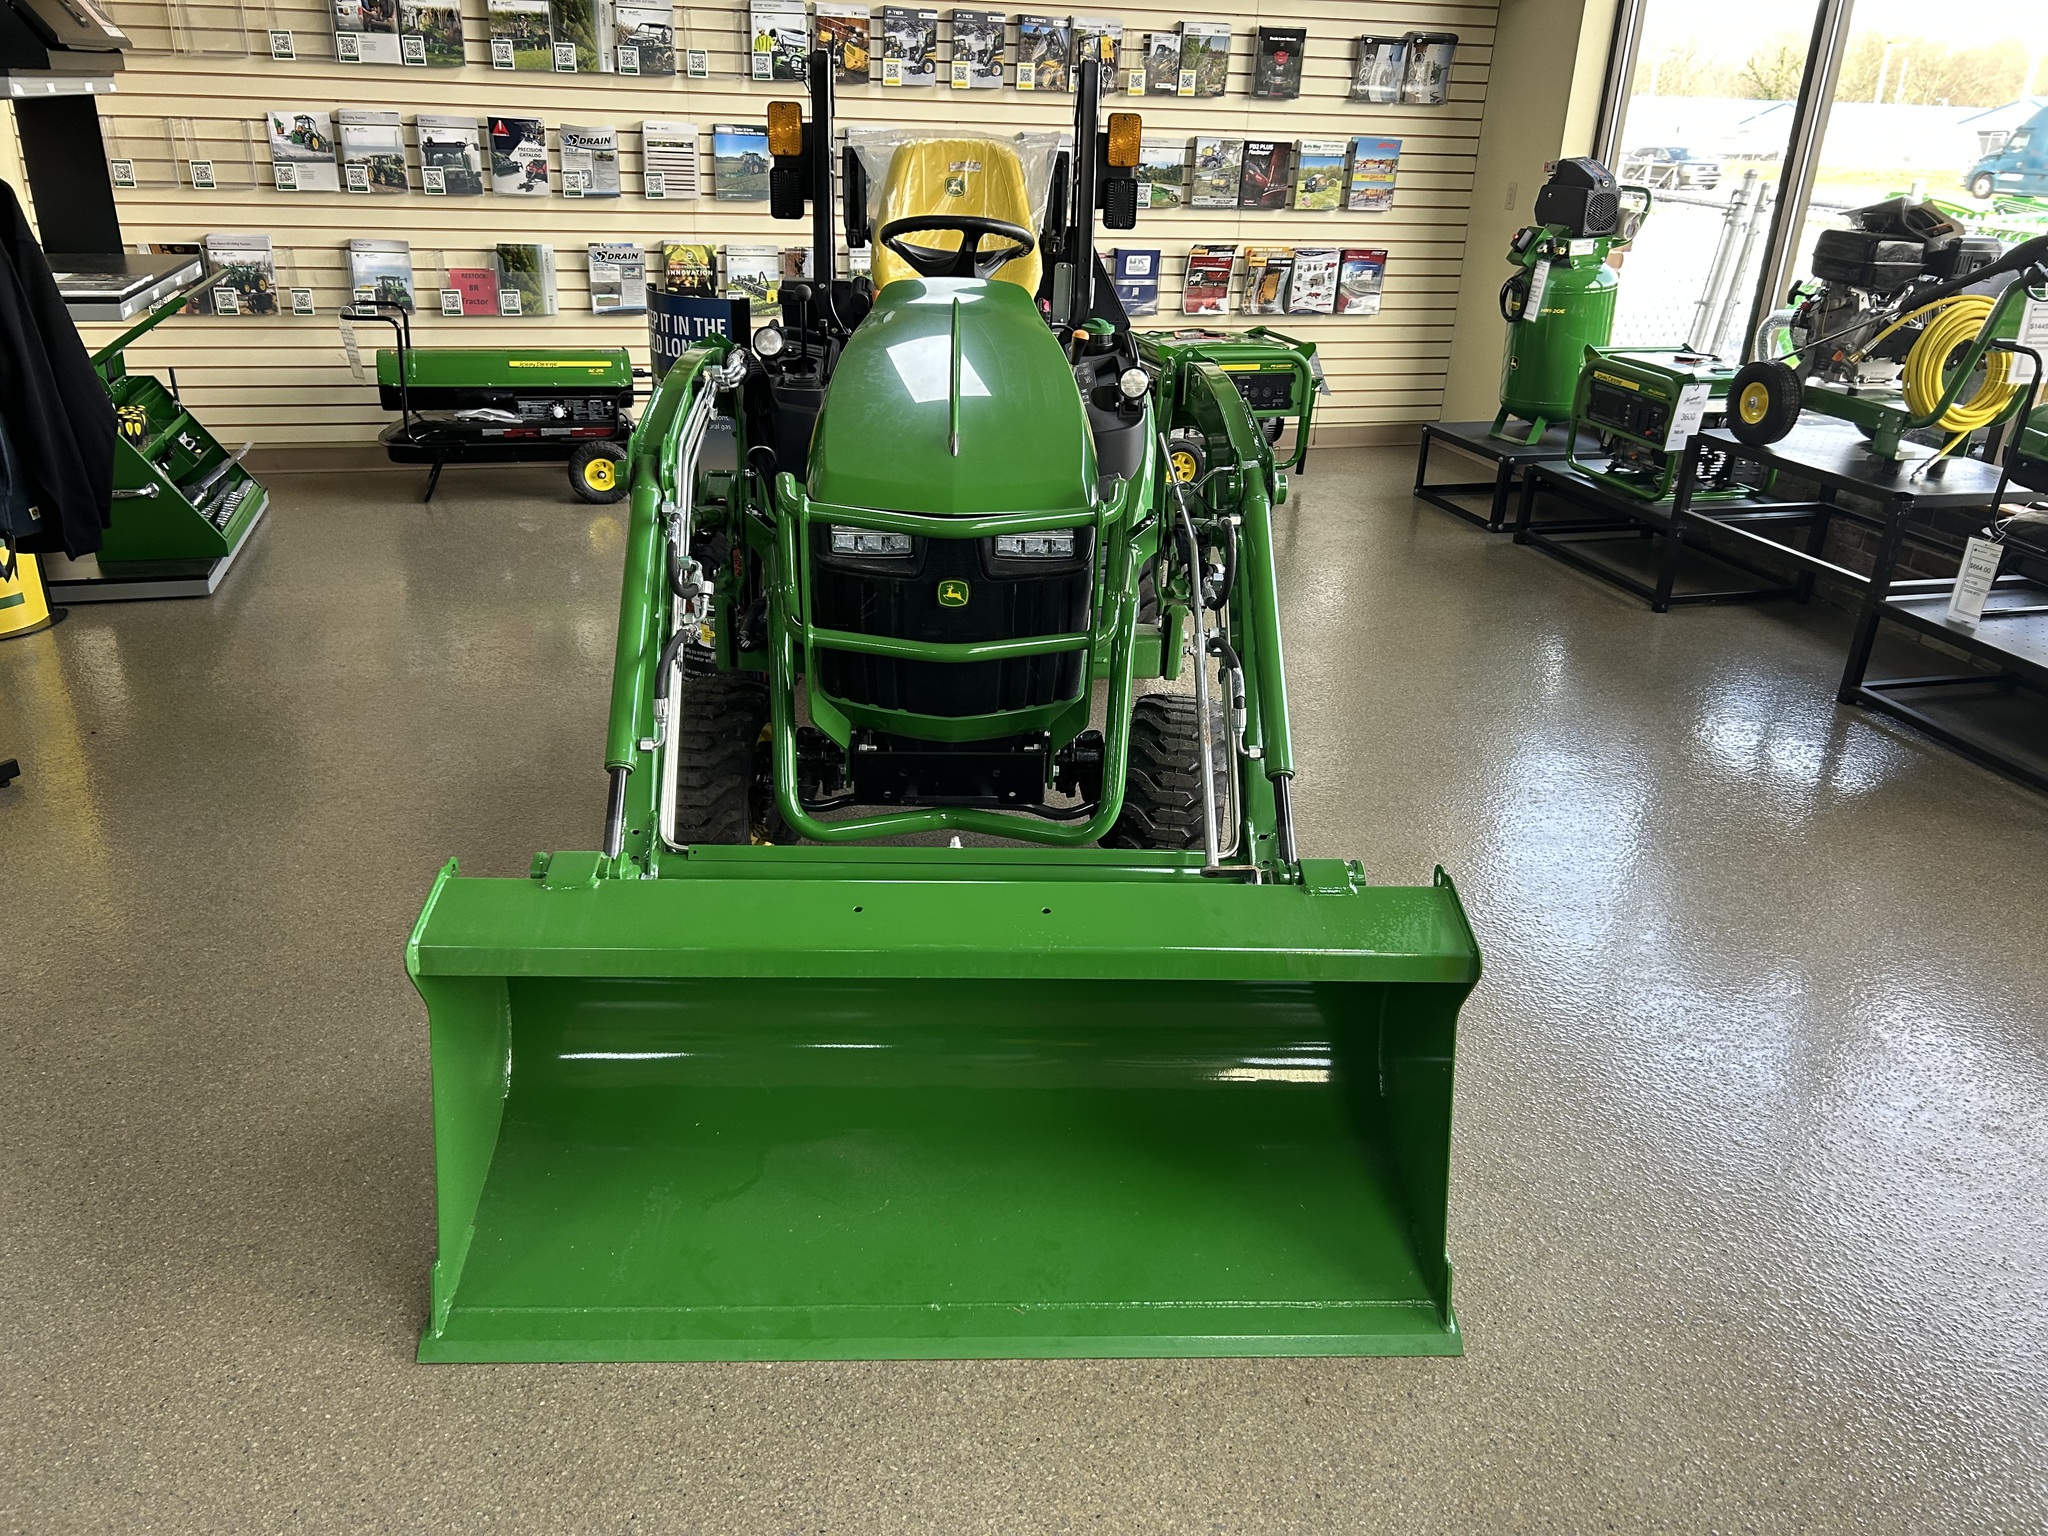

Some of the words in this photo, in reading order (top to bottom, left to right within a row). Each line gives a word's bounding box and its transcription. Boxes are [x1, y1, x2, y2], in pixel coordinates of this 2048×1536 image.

[579, 136, 611, 145] DRAIN
[607, 252, 638, 260] DRAIN
[660, 312, 670, 333] IT
[673, 315, 689, 336] IN
[693, 317, 726, 338] THE
[721, 424, 732, 432] gas
[1969, 562, 1991, 574] $664.00
